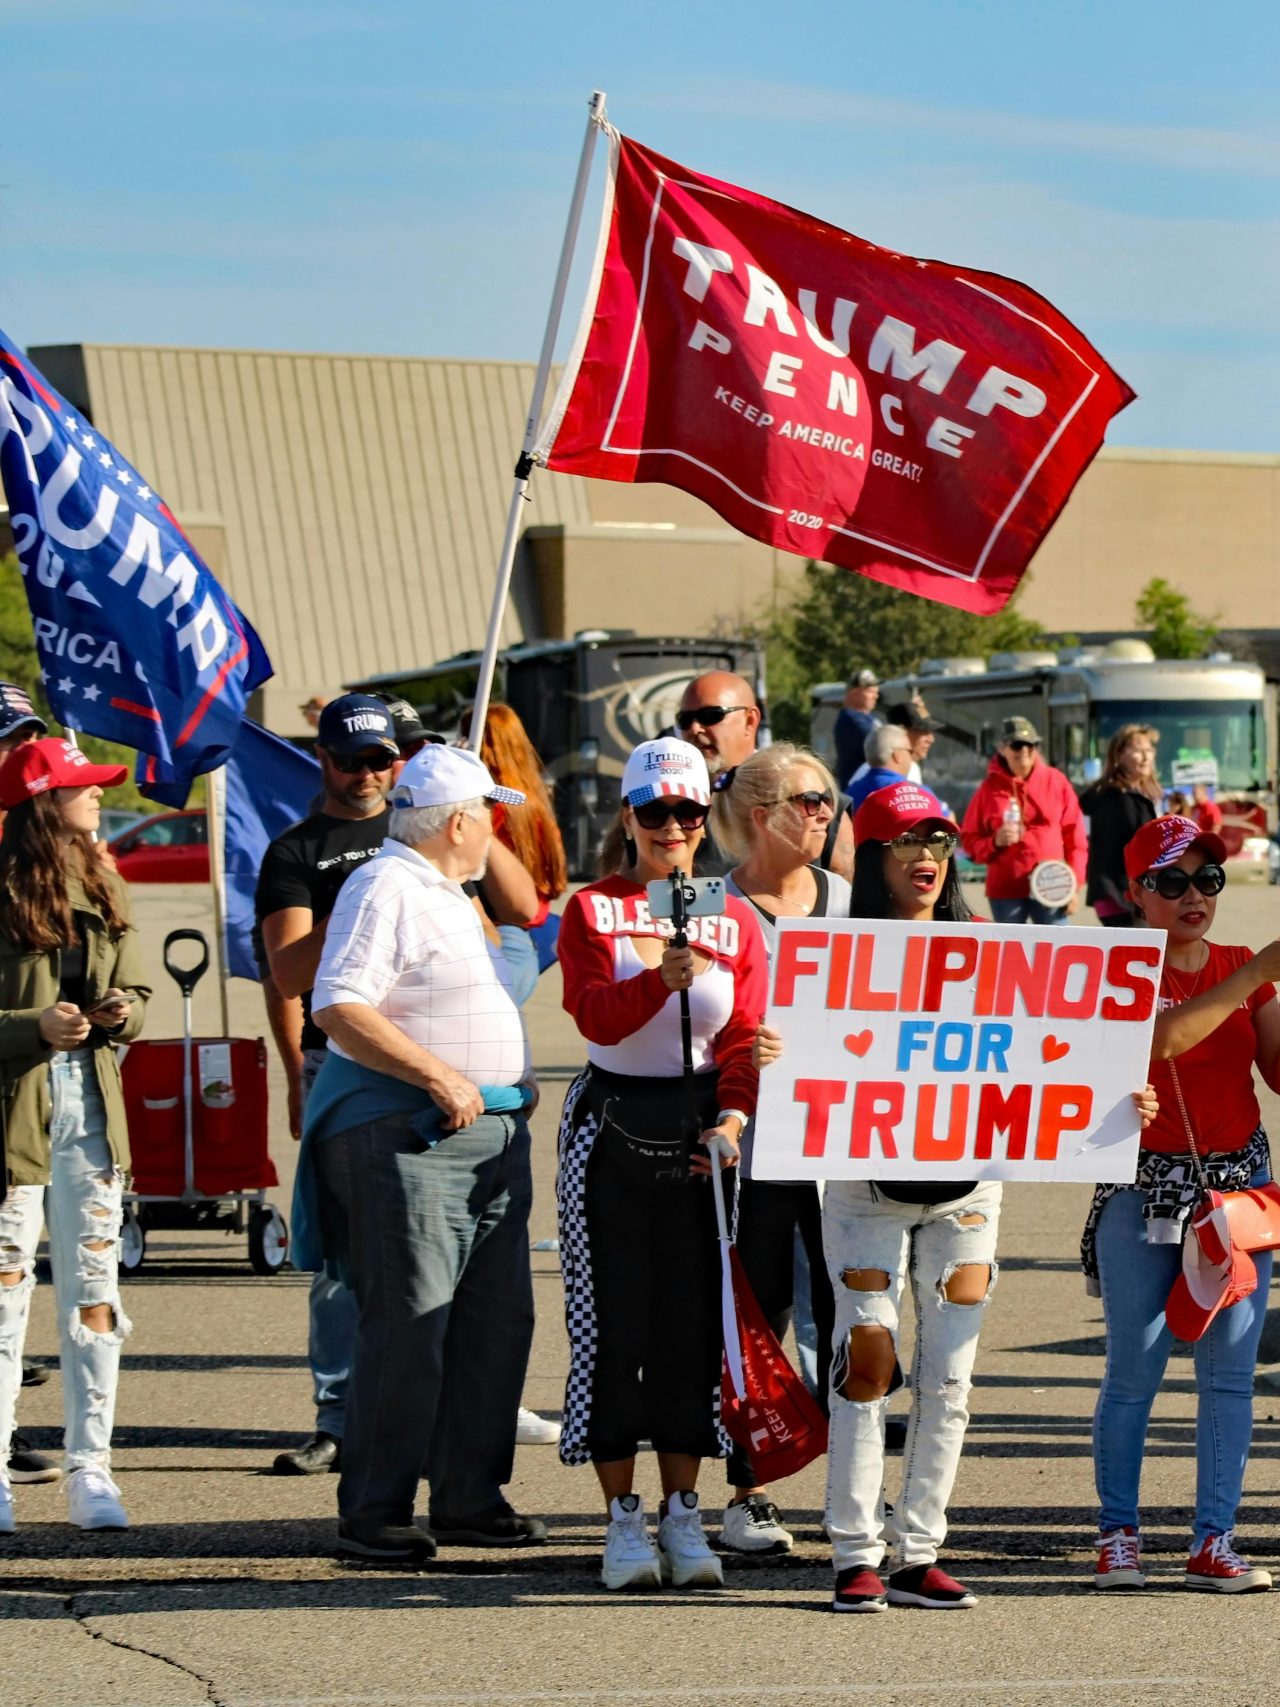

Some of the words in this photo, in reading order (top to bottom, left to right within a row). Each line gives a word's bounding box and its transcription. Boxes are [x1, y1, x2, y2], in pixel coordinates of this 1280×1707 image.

[673, 237, 1047, 418] TRUMP
[688, 319, 976, 458] PENCE
[714, 386, 775, 428] KEEP
[778, 420, 865, 461] AMERICA
[872, 449, 923, 483] GREAT!
[787, 509, 823, 530] 2020
[34, 615, 121, 674] RICA
[343, 713, 388, 733] TRUMP
[643, 751, 693, 765] Trump
[894, 785, 919, 795] KEEP
[896, 802, 929, 812] GREAT
[317, 855, 342, 870] ONLY
[343, 850, 366, 861] YOU
[367, 846, 384, 857] CA
[773, 929, 1162, 1021] FILIPINOS
[895, 1020, 1014, 1073] FOR
[794, 1077, 1093, 1162] TRUMP
[763, 1407, 793, 1443] KEEP
